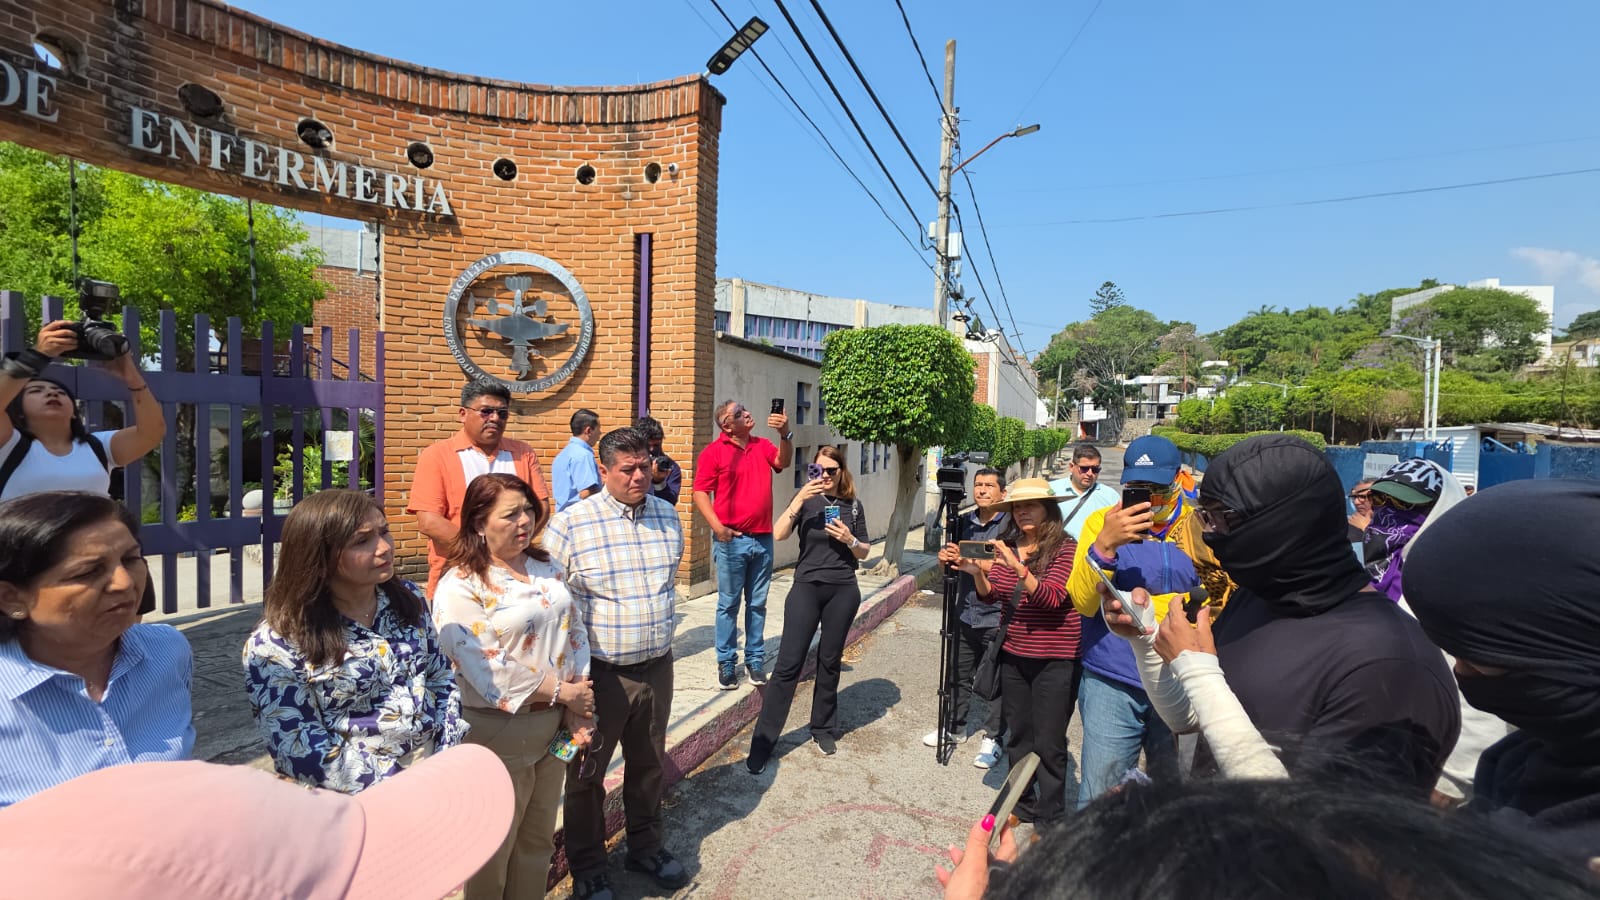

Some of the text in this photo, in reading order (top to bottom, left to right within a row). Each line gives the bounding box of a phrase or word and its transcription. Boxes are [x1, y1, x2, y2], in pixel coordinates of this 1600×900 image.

[0, 59, 453, 216] DE ENFERMERIA
[449, 254, 498, 302] FACULTAD
[443, 315, 475, 374] UNIVERSIDAD
[574, 319, 593, 362] MORELOS
